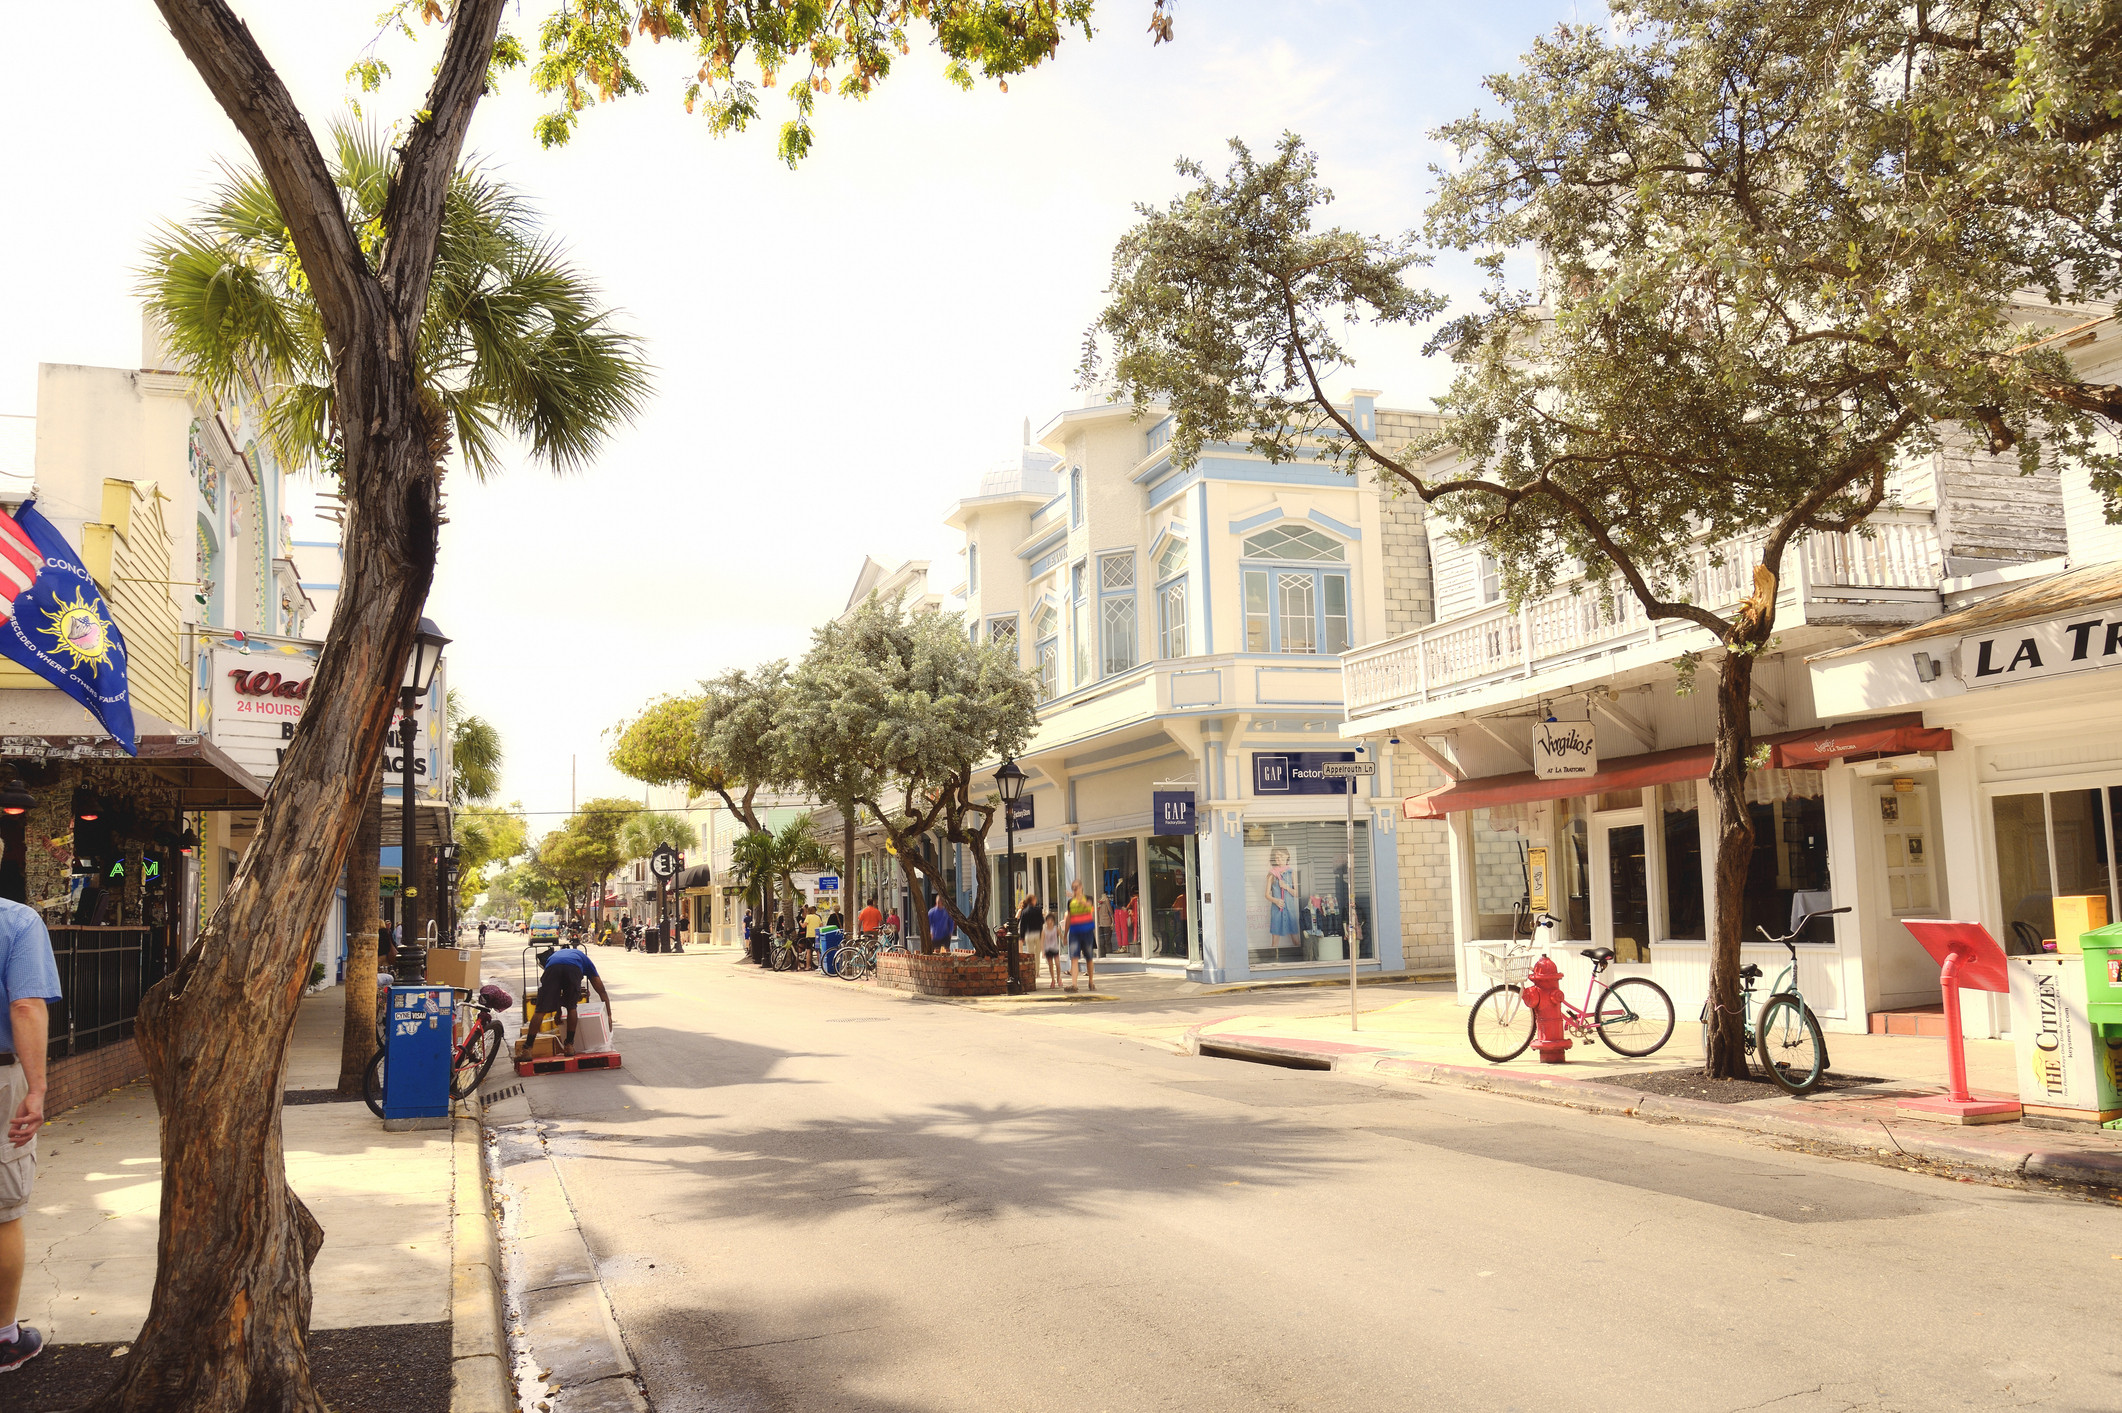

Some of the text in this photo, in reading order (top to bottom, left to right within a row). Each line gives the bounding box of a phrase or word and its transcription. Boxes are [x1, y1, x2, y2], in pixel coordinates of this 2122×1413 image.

[46, 557, 94, 587] CONCH
[9, 615, 37, 652] SECEDED
[36, 650, 67, 675] WHERE
[69, 673, 98, 701] OTHERS
[1975, 618, 2122, 677] LA TR
[237, 700, 301, 716] 24 HOURS
[1537, 724, 1594, 756] Virgilio's
[1264, 766, 1282, 781] GAP
[1325, 765, 1373, 774] Appelrouth Ln
[1164, 802, 1187, 820] GAP
[109, 861, 159, 877] AM
[2035, 974, 2063, 1097] THE CITIZEN
[2064, 1007, 2074, 1058] keysnews.com
